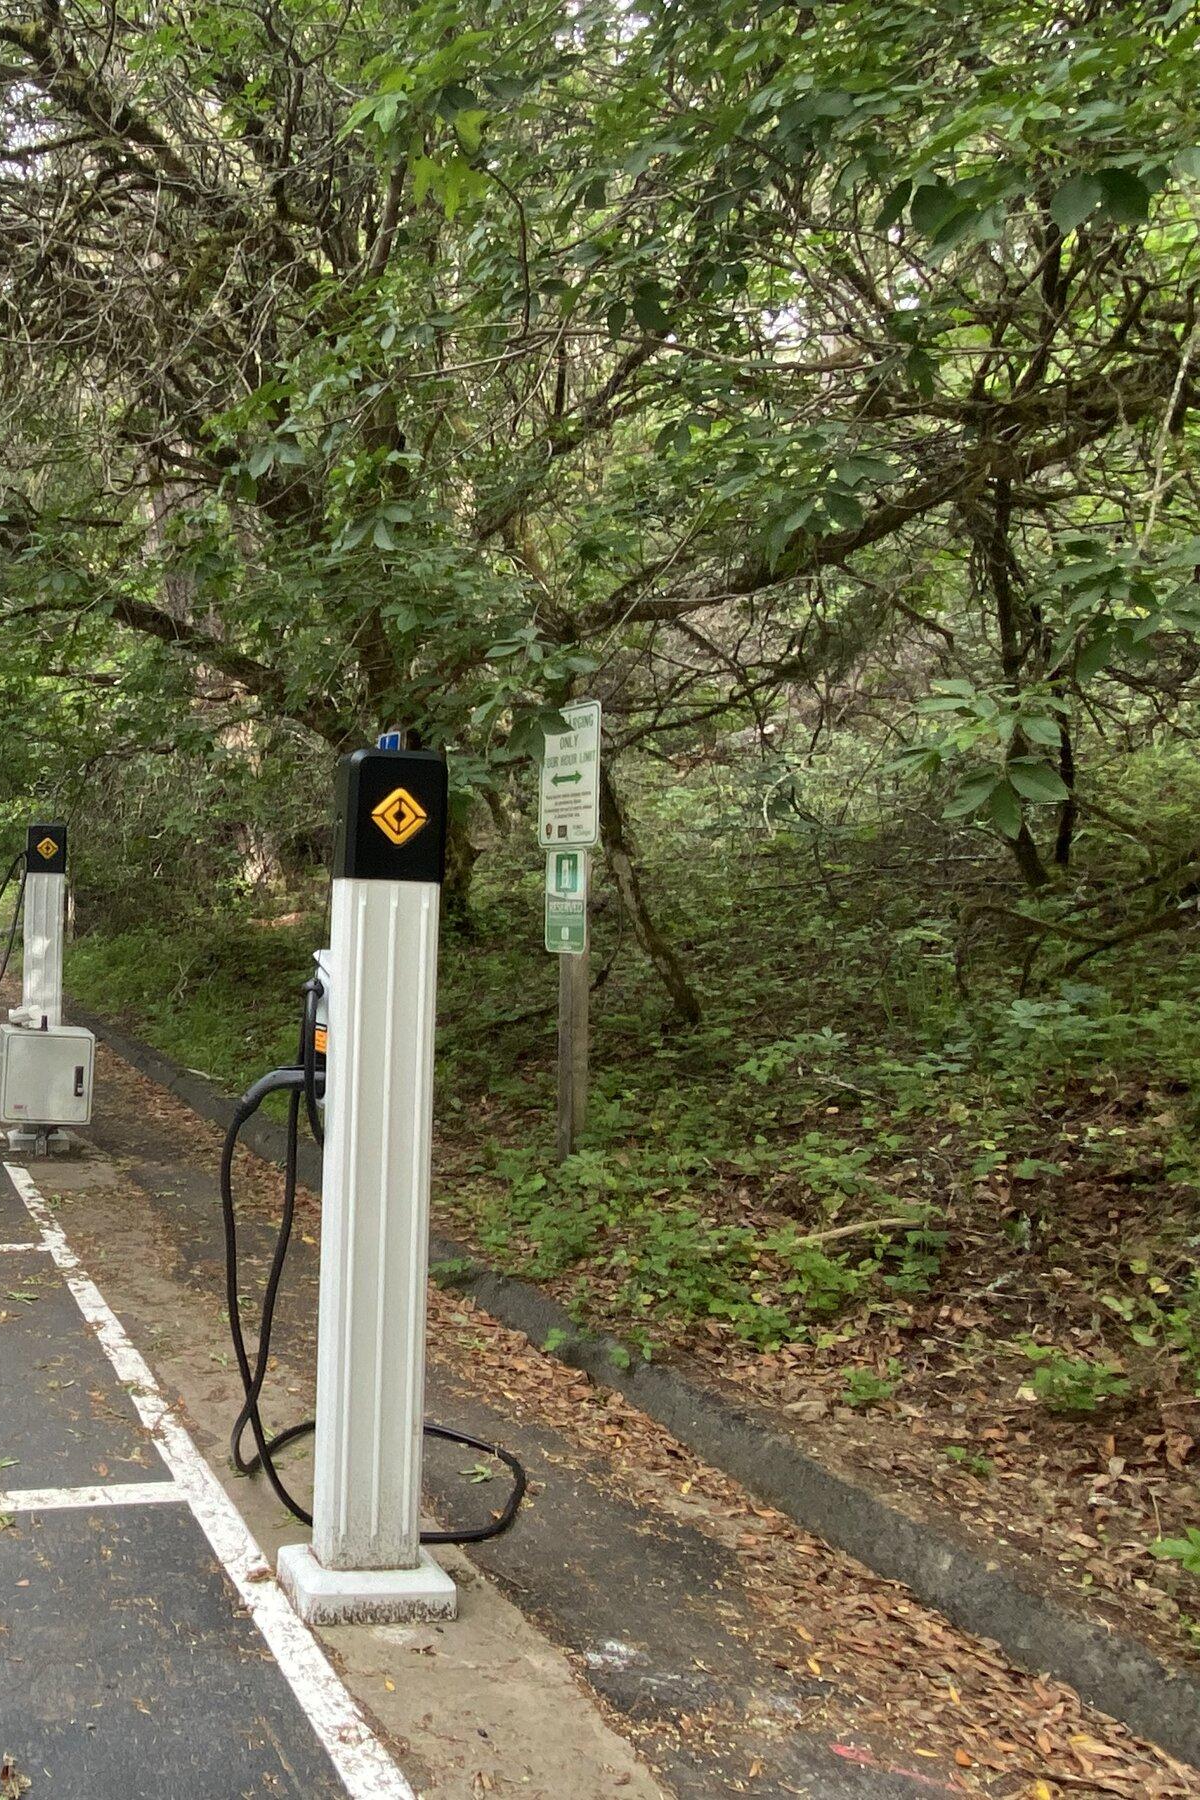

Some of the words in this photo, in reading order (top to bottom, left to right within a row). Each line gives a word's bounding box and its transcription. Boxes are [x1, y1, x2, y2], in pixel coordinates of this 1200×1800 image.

[560, 734, 579, 750] ONLY
[561, 753, 577, 766] HOUR
[579, 750, 595, 763] LIMIT
